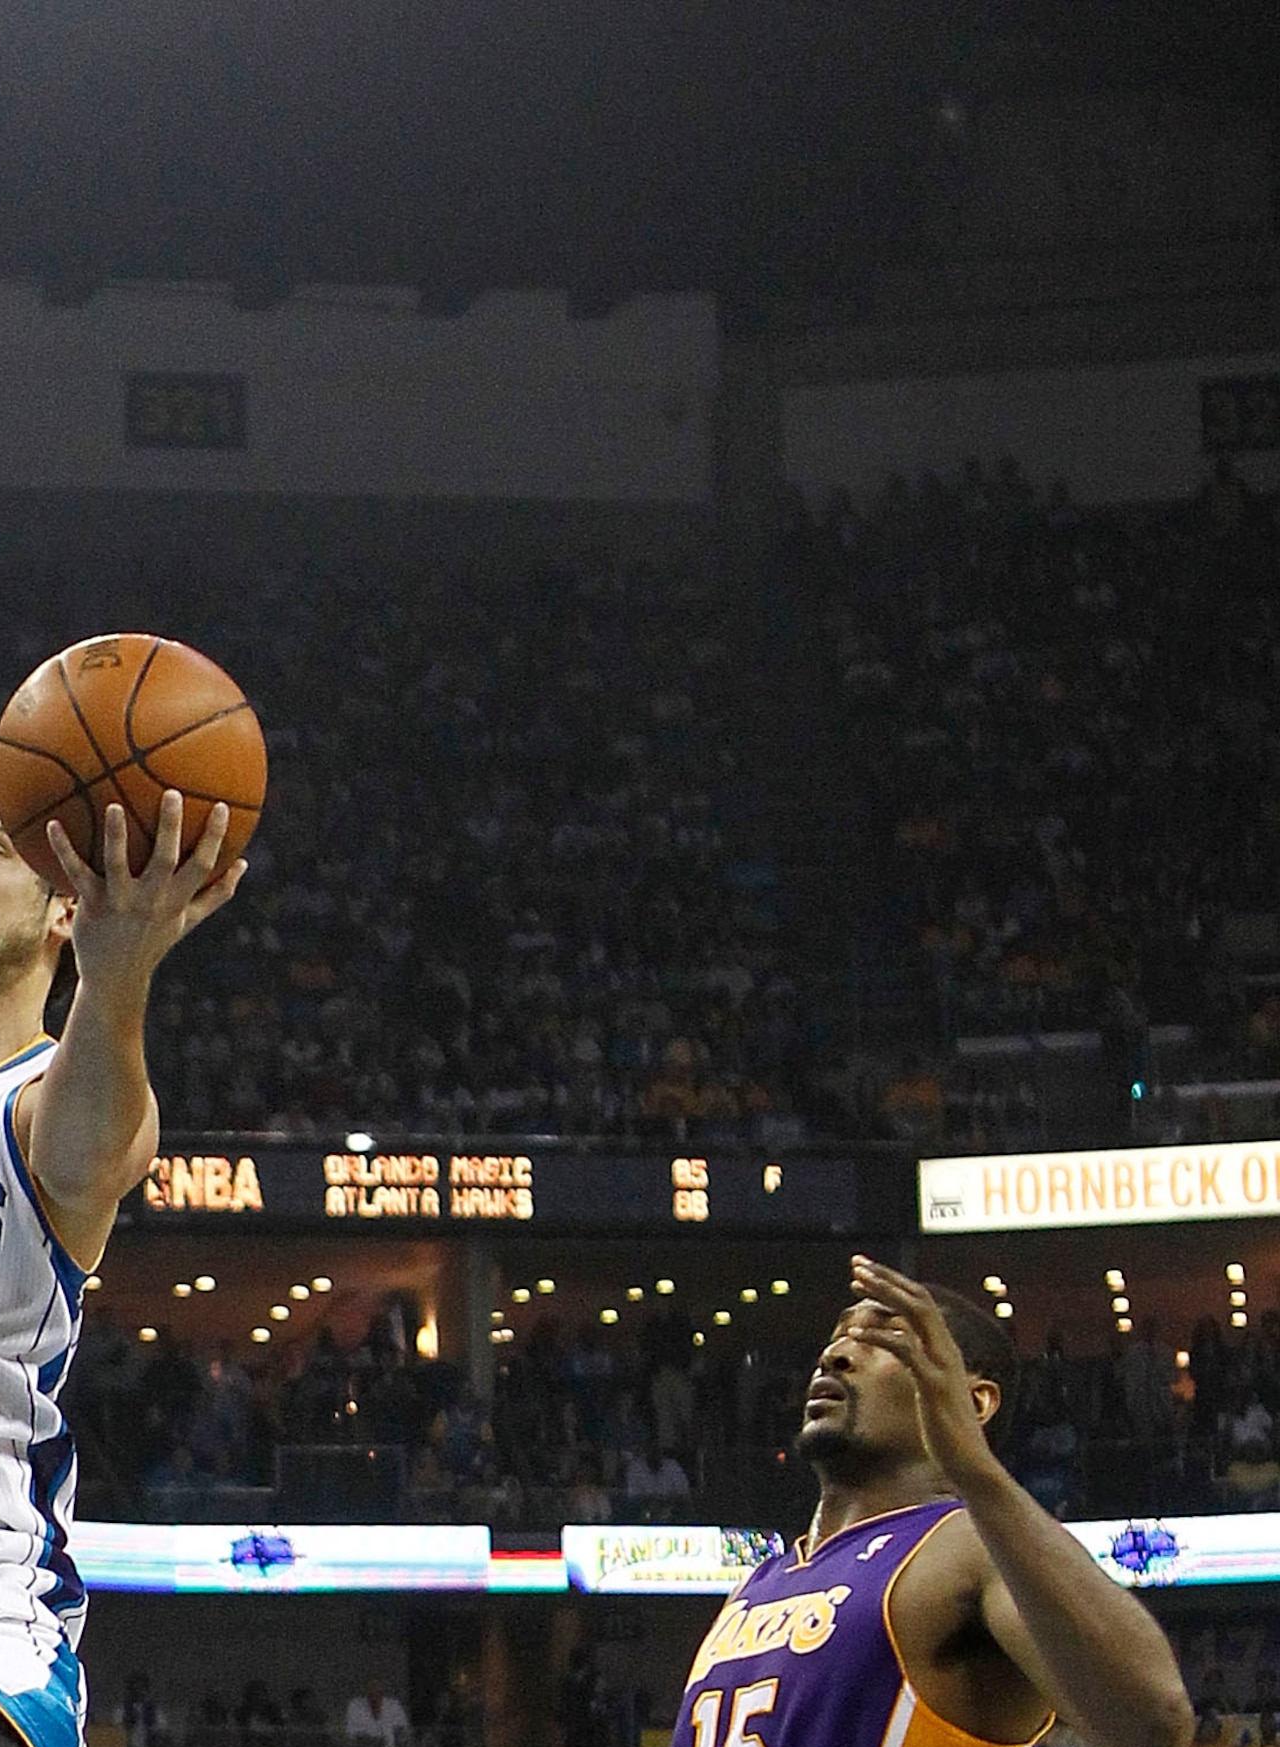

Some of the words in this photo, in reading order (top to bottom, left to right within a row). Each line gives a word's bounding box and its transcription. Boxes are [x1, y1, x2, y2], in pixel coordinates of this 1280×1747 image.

[169, 1155, 264, 1212] NBA
[324, 1154, 439, 1186] ORLANDO
[450, 1155, 533, 1188] MAGIC
[982, 1155, 1225, 1216] HORNBECK
[325, 1186, 440, 1217] ATLANTA
[450, 1187, 534, 1219] HAWKS
[684, 1584, 853, 1694] LAKERS
